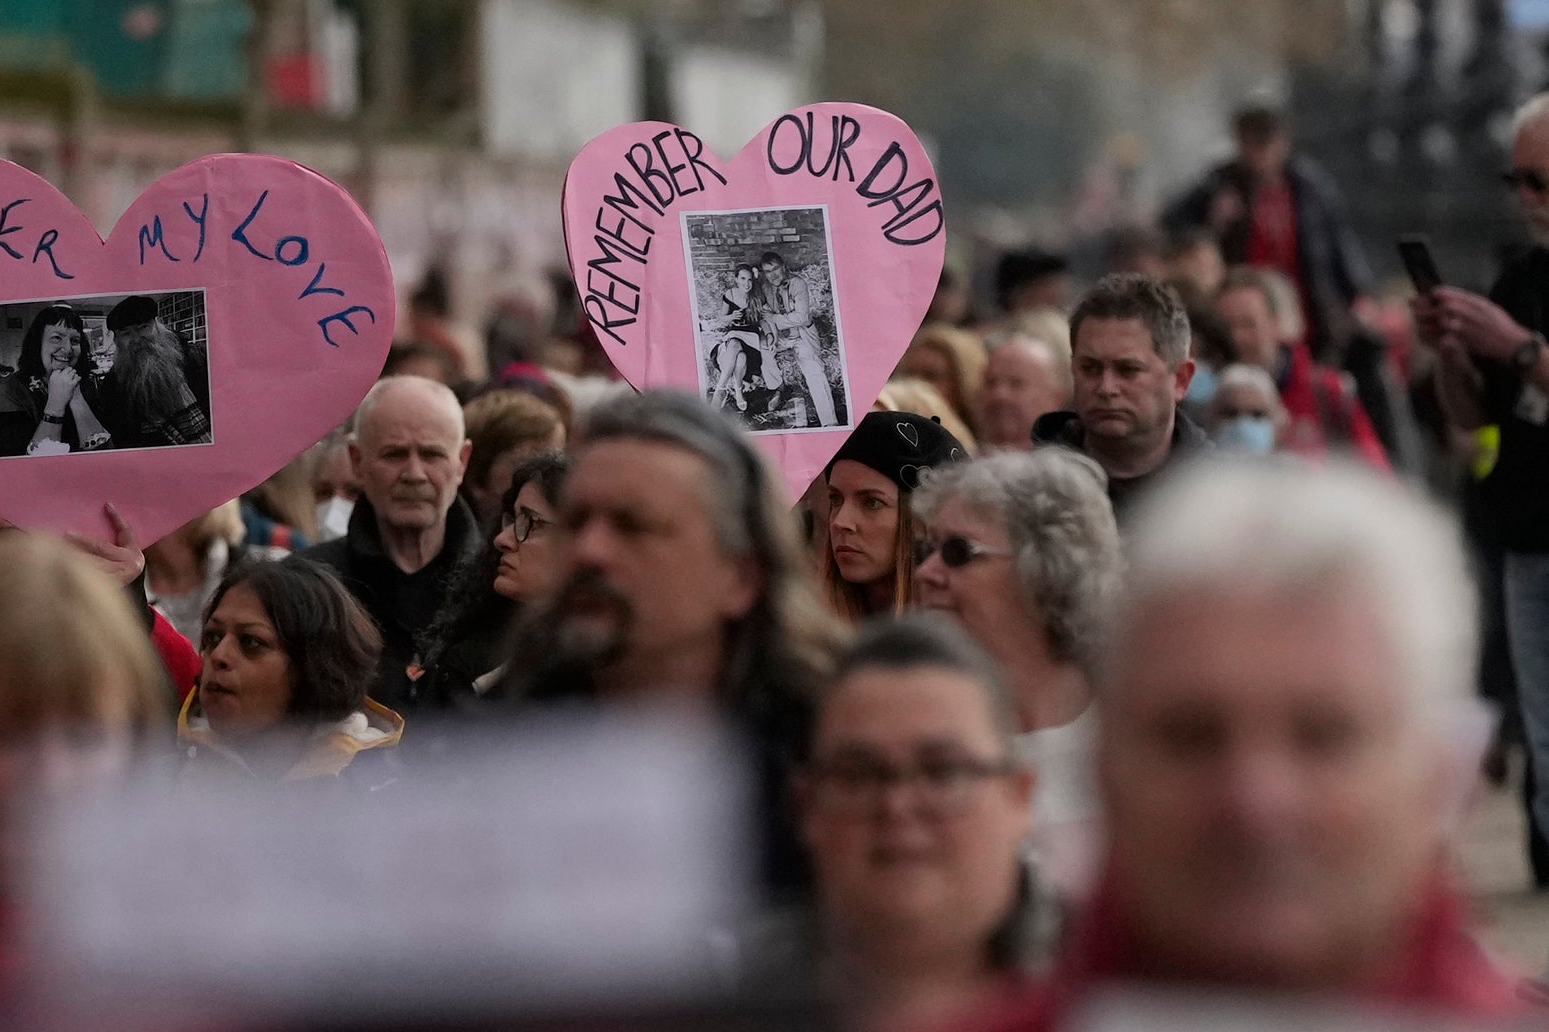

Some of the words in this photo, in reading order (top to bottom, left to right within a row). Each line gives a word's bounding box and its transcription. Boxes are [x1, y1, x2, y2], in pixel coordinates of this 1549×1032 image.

[139, 193, 208, 265] MY
[231, 190, 375, 347] LOVE
[584, 127, 727, 346] REMEMBER
[766, 111, 861, 182] OUR
[855, 141, 944, 246] DAD
